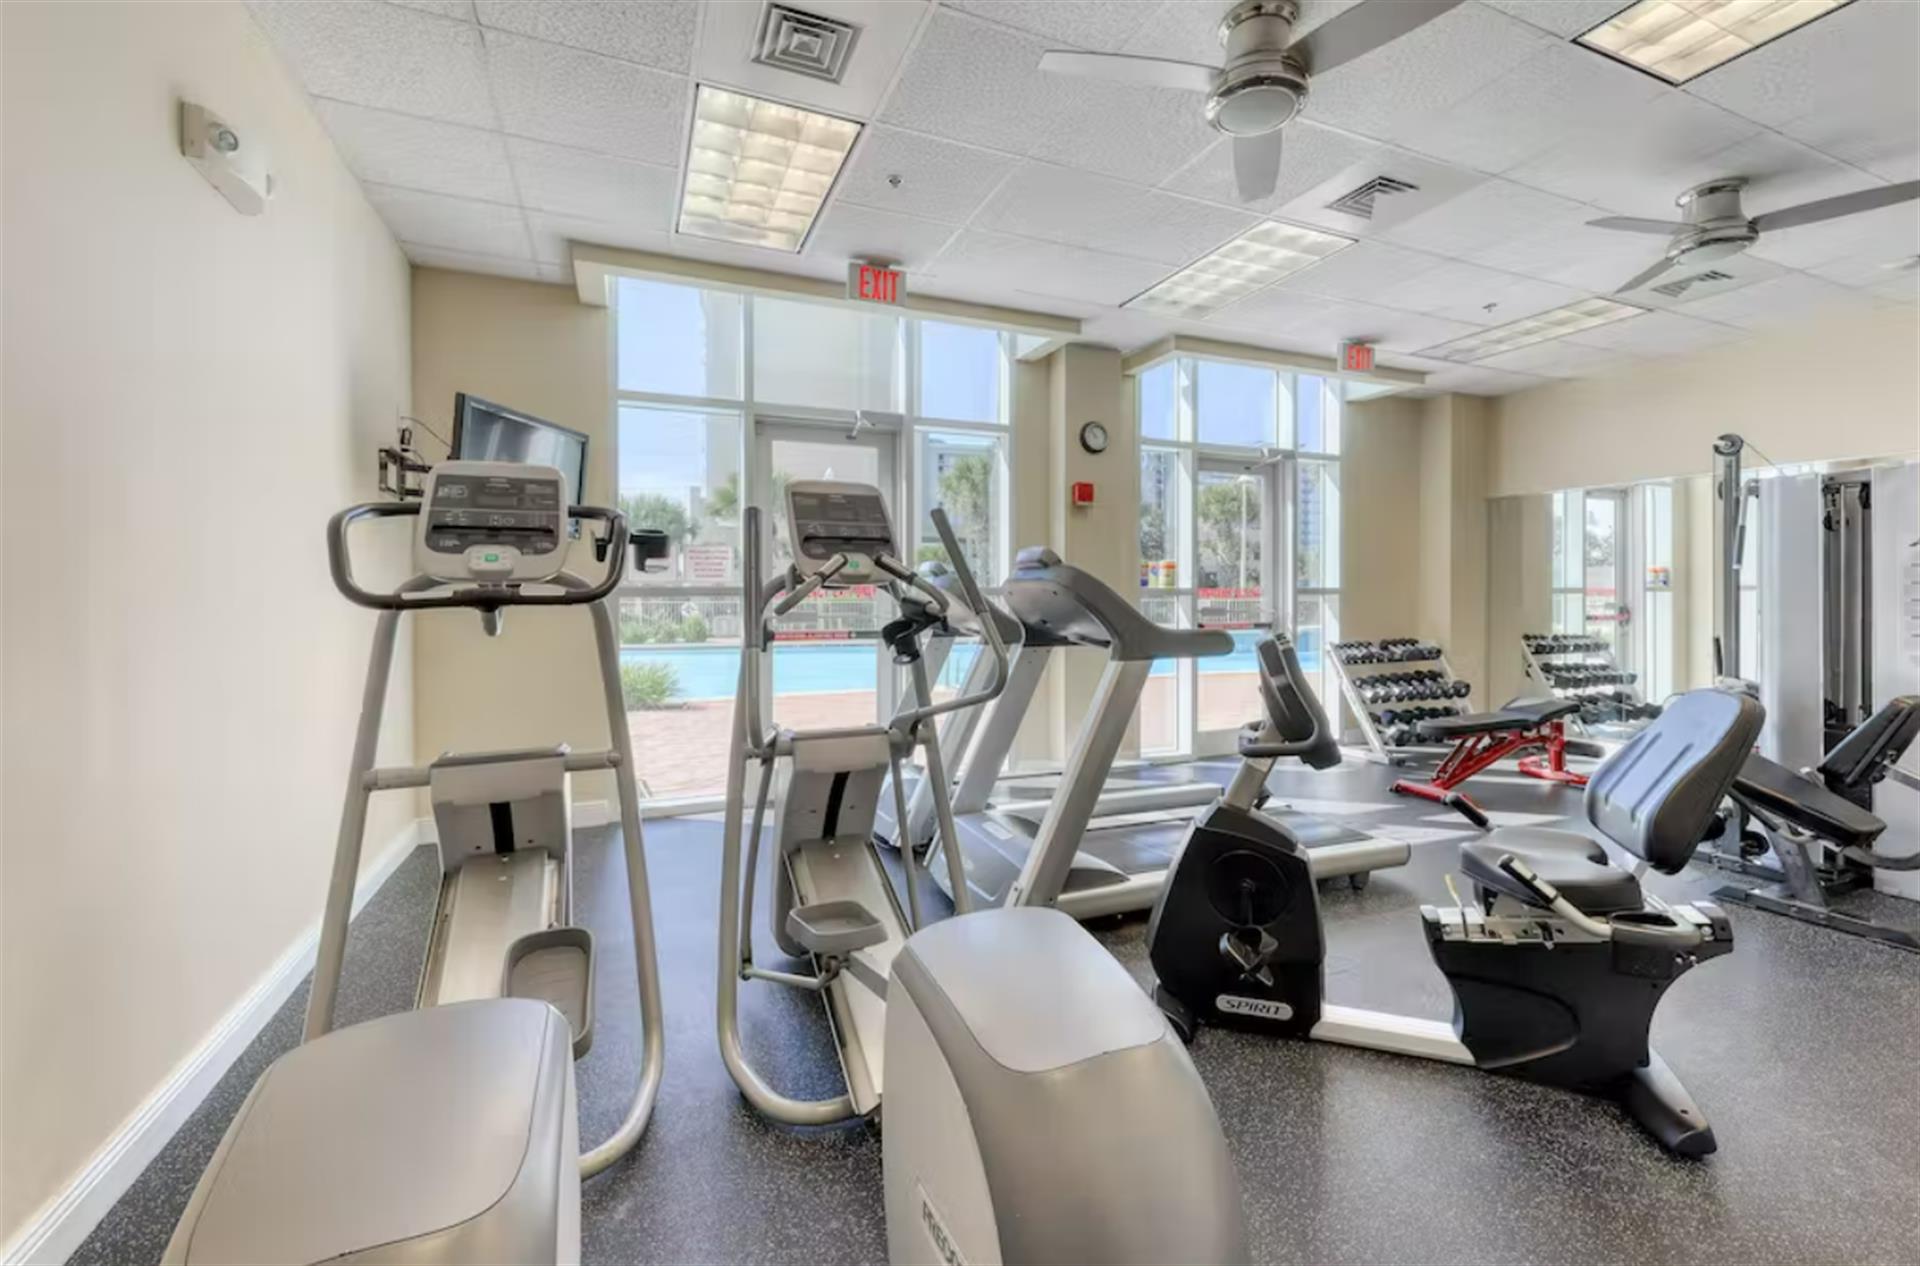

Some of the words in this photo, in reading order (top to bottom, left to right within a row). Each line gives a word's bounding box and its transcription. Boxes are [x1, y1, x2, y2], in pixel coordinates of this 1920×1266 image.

[858, 264, 899, 304] EXIT
[1346, 344, 1373, 370] EXIT
[1225, 999, 1280, 1016] SPIRIT
